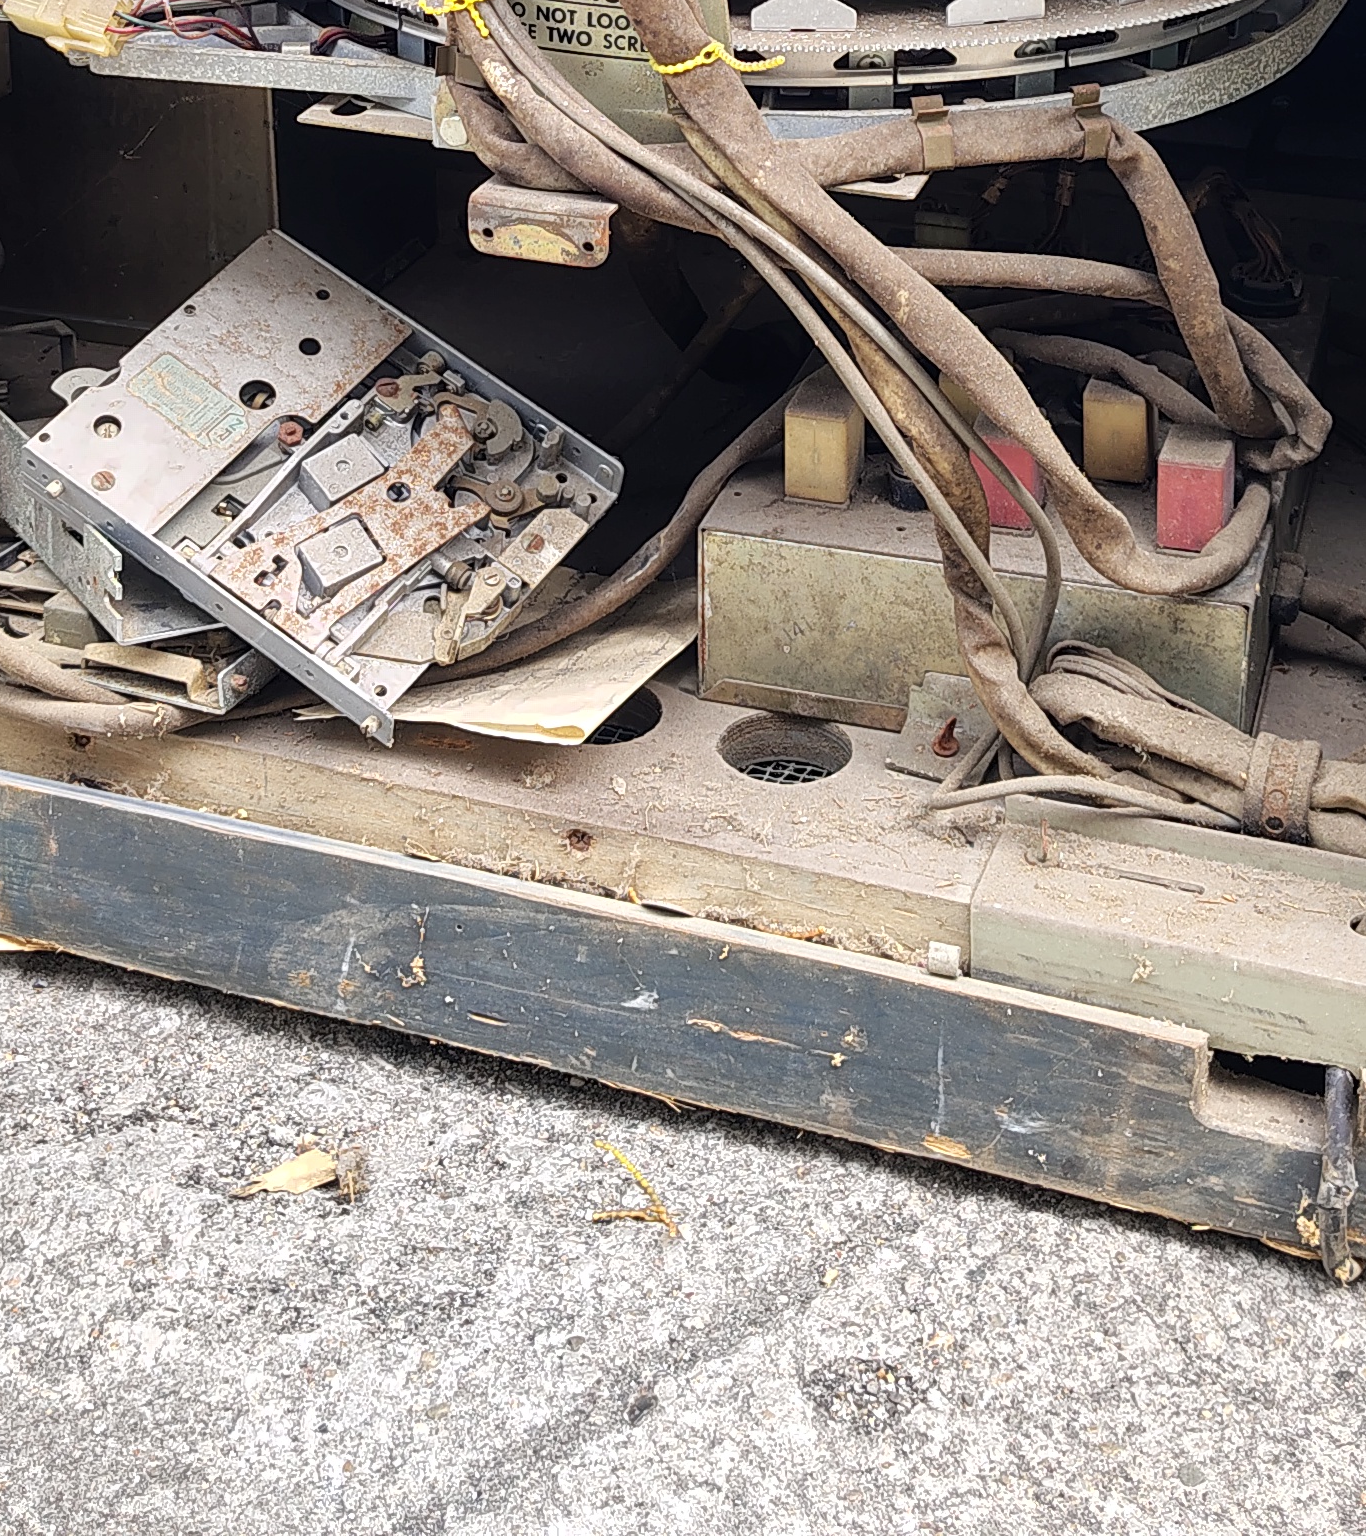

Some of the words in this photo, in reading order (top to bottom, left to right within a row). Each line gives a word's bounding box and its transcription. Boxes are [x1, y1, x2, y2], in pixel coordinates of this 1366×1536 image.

[511, 2, 526, 18] O
[537, 5, 577, 26] NOT
[547, 26, 593, 46] TWO
